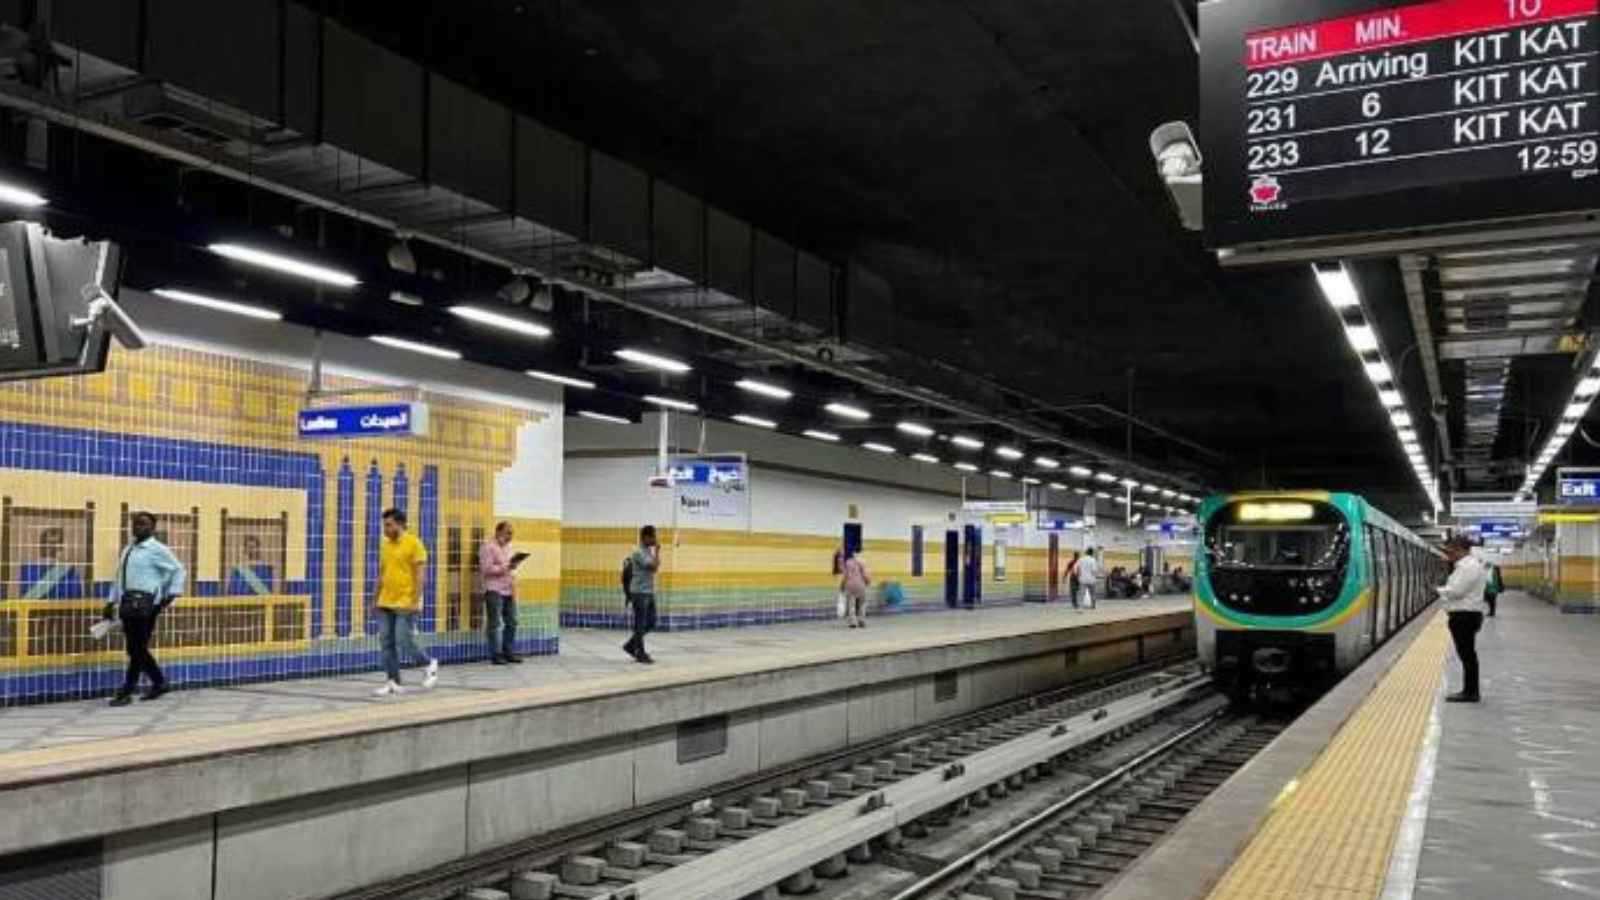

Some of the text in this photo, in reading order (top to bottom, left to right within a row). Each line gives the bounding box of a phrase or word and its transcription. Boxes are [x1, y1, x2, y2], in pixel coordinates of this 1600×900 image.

[1247, 30, 1317, 62] TRAIN
[1247, 21, 1587, 99] 229 Arriving KIT KAT
[1247, 62, 1587, 134] 231 6 KIT KAT
[1248, 102, 1586, 170] 233 12 KIT KAT
[1517, 139, 1598, 171] 12:59
